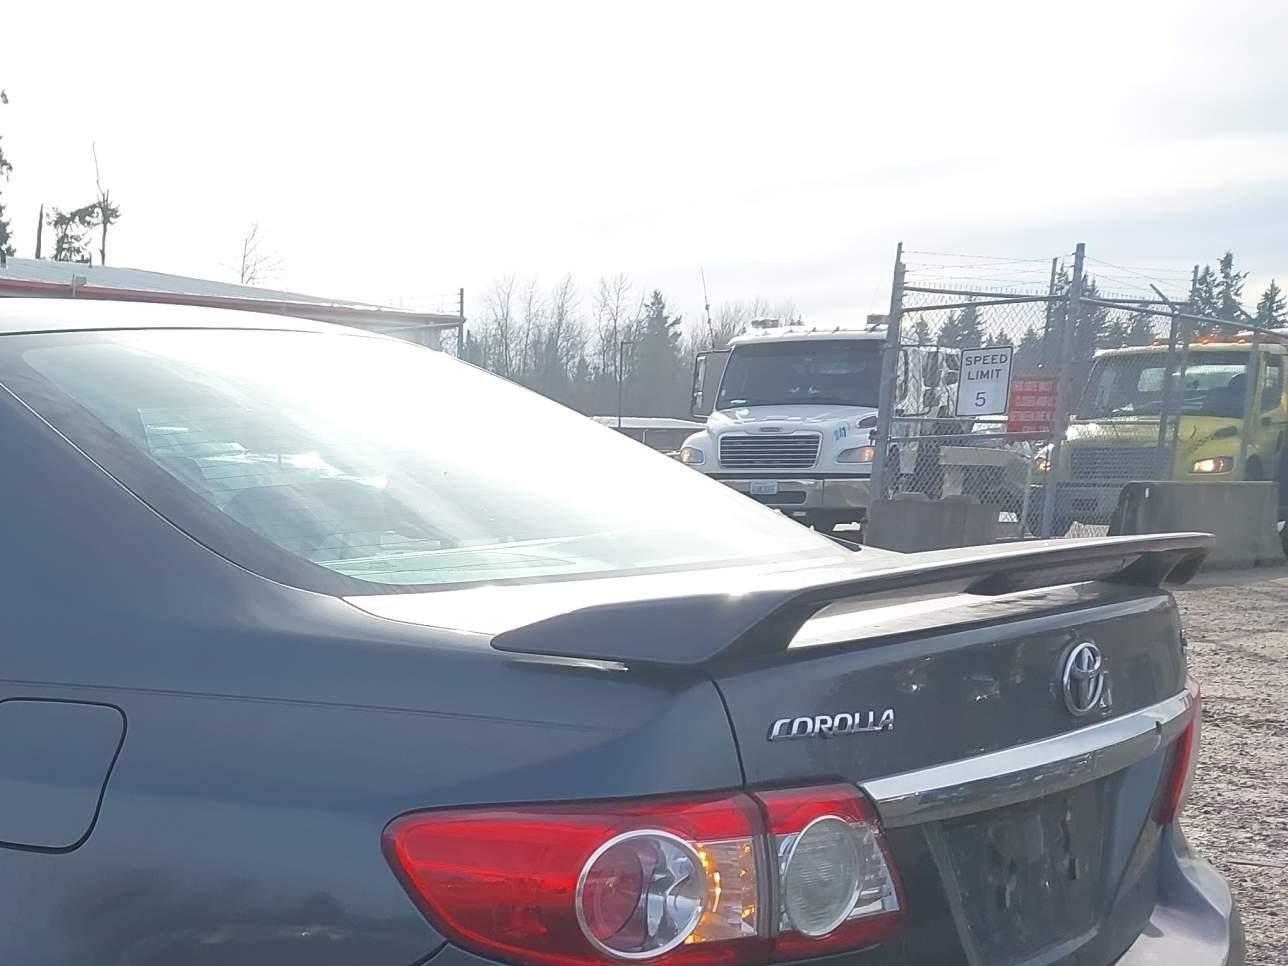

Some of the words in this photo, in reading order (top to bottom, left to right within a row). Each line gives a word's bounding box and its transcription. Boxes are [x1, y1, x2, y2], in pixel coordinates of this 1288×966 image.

[965, 354, 1008, 366] SPEED
[968, 369, 1002, 380] LIMIT
[975, 391, 987, 407] 5
[768, 708, 894, 740] COROLLA
